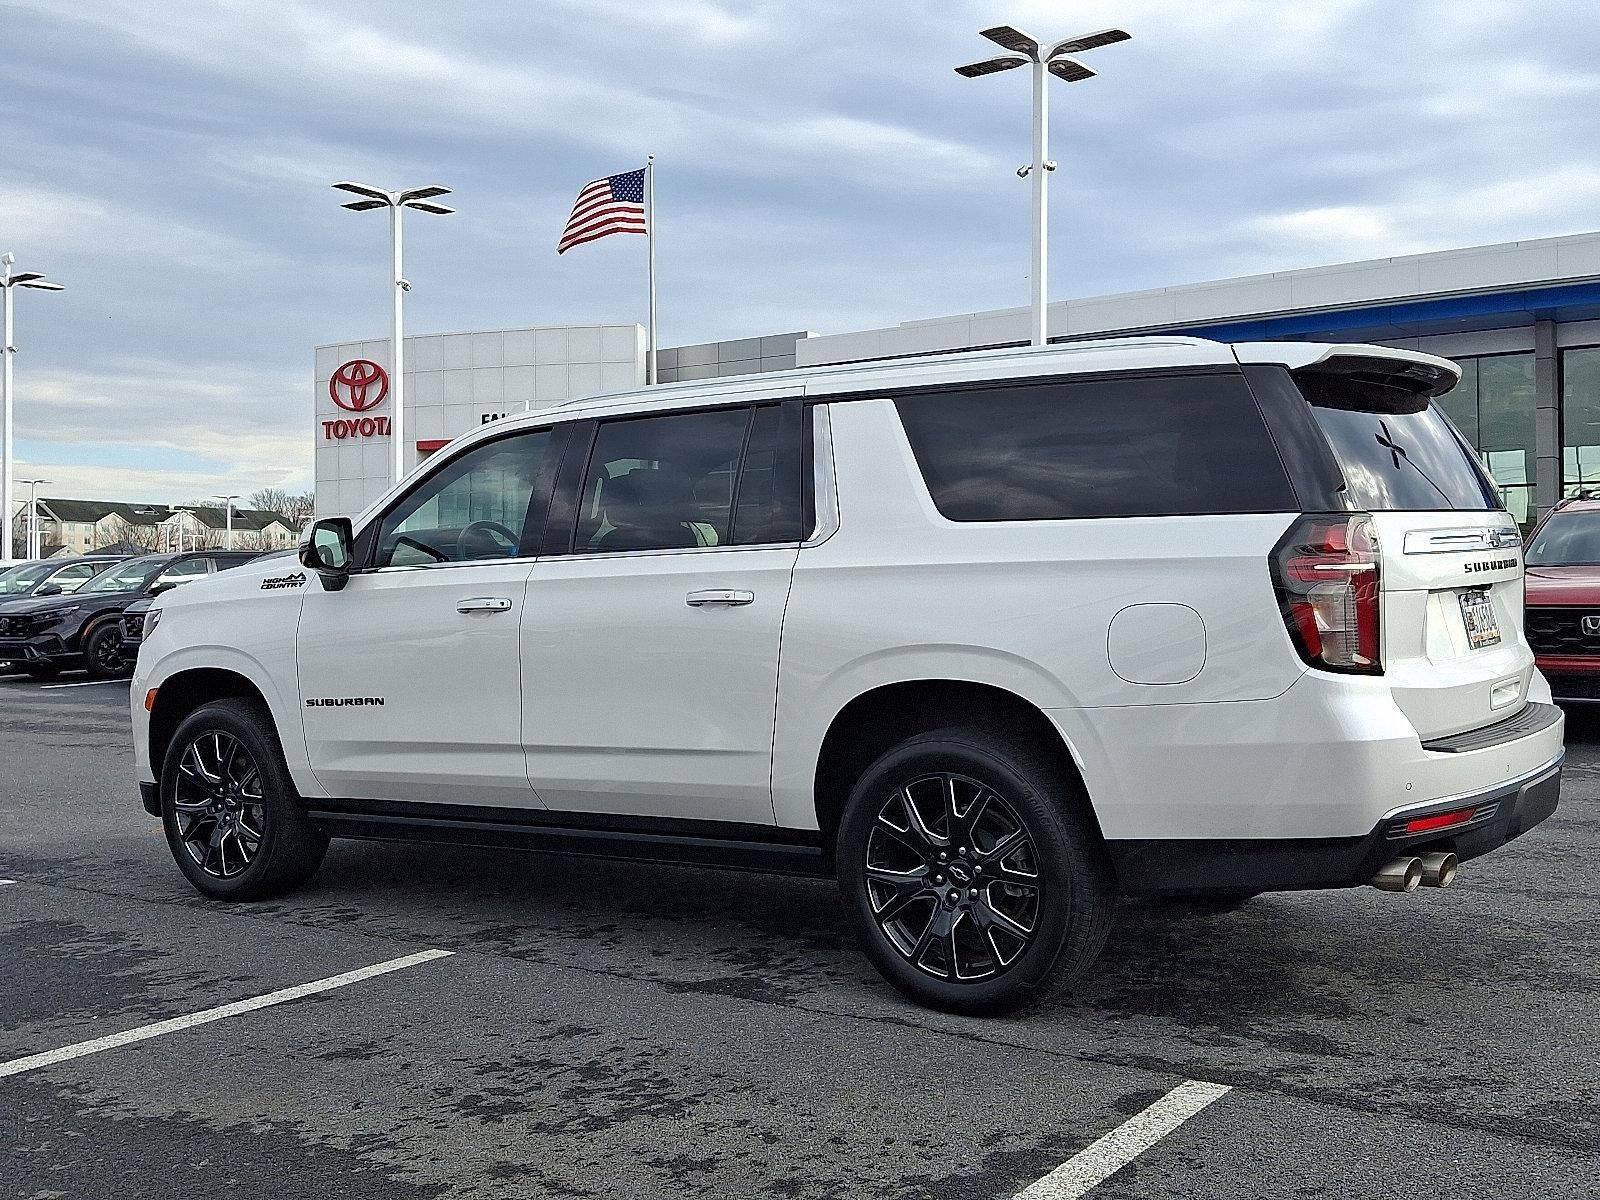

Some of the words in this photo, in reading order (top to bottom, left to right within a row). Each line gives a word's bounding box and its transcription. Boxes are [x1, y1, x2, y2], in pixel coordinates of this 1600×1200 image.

[260, 581, 306, 590] COUNTRY
[262, 577, 286, 585] HIGH
[305, 697, 385, 708] SUBURBAN
